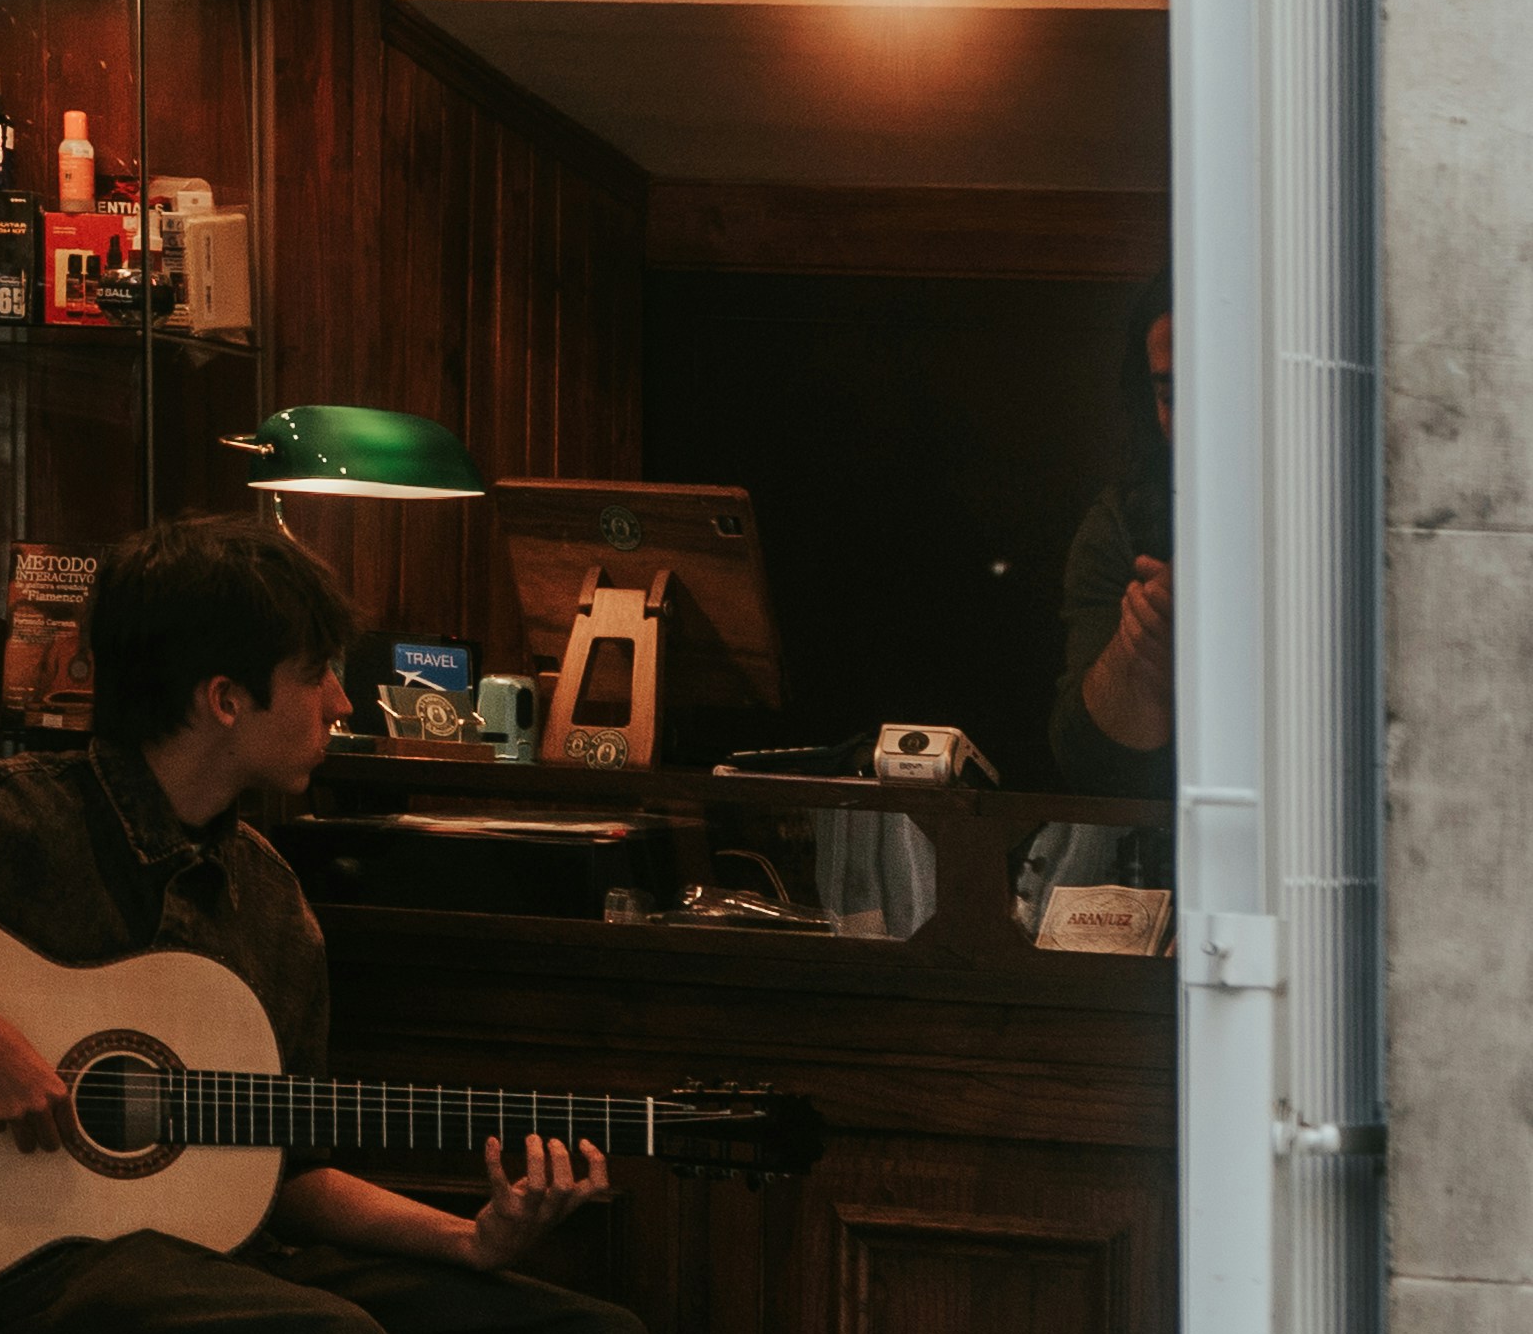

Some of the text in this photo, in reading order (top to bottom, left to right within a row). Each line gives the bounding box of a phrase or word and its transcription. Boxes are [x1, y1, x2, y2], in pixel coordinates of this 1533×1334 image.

[97, 200, 165, 214] ENTIAS
[15, 570, 95, 584] INTERACTIVO
[405, 651, 458, 669] TRAVEL
[1067, 912, 1133, 927] ARANJUEZ
